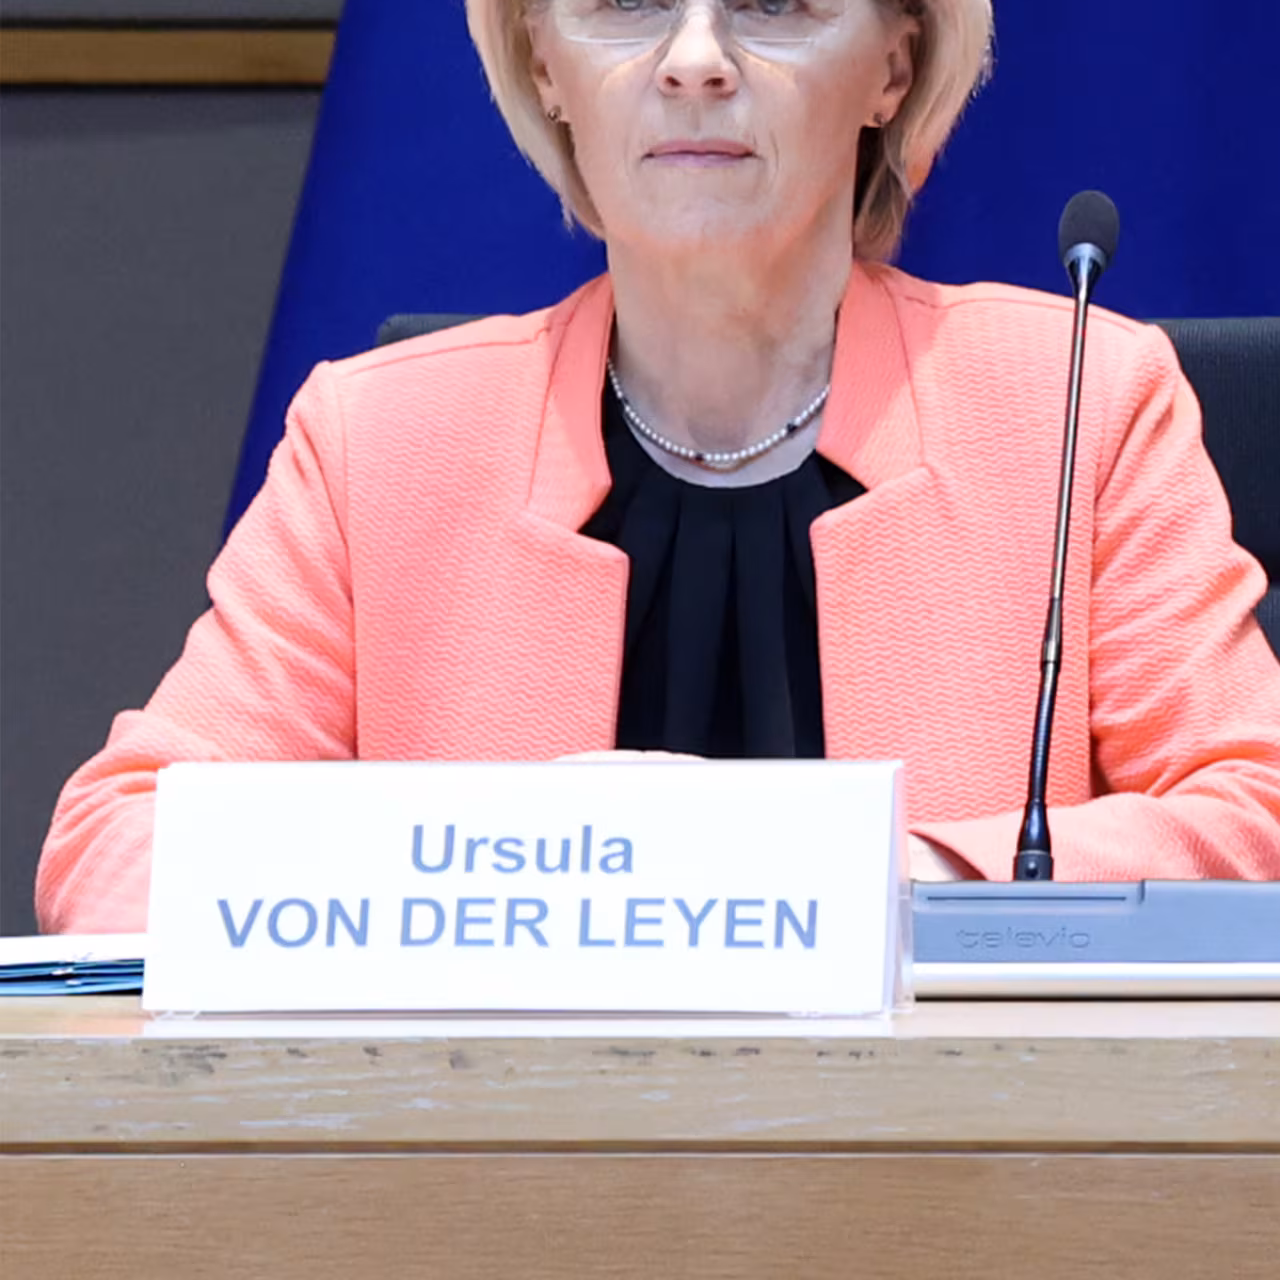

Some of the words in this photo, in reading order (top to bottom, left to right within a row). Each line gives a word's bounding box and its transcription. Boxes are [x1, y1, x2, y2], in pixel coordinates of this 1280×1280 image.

[410, 823, 634, 875] Ursula
[216, 897, 372, 949] VON
[399, 897, 550, 948] DER
[577, 897, 819, 949] LEYEN
